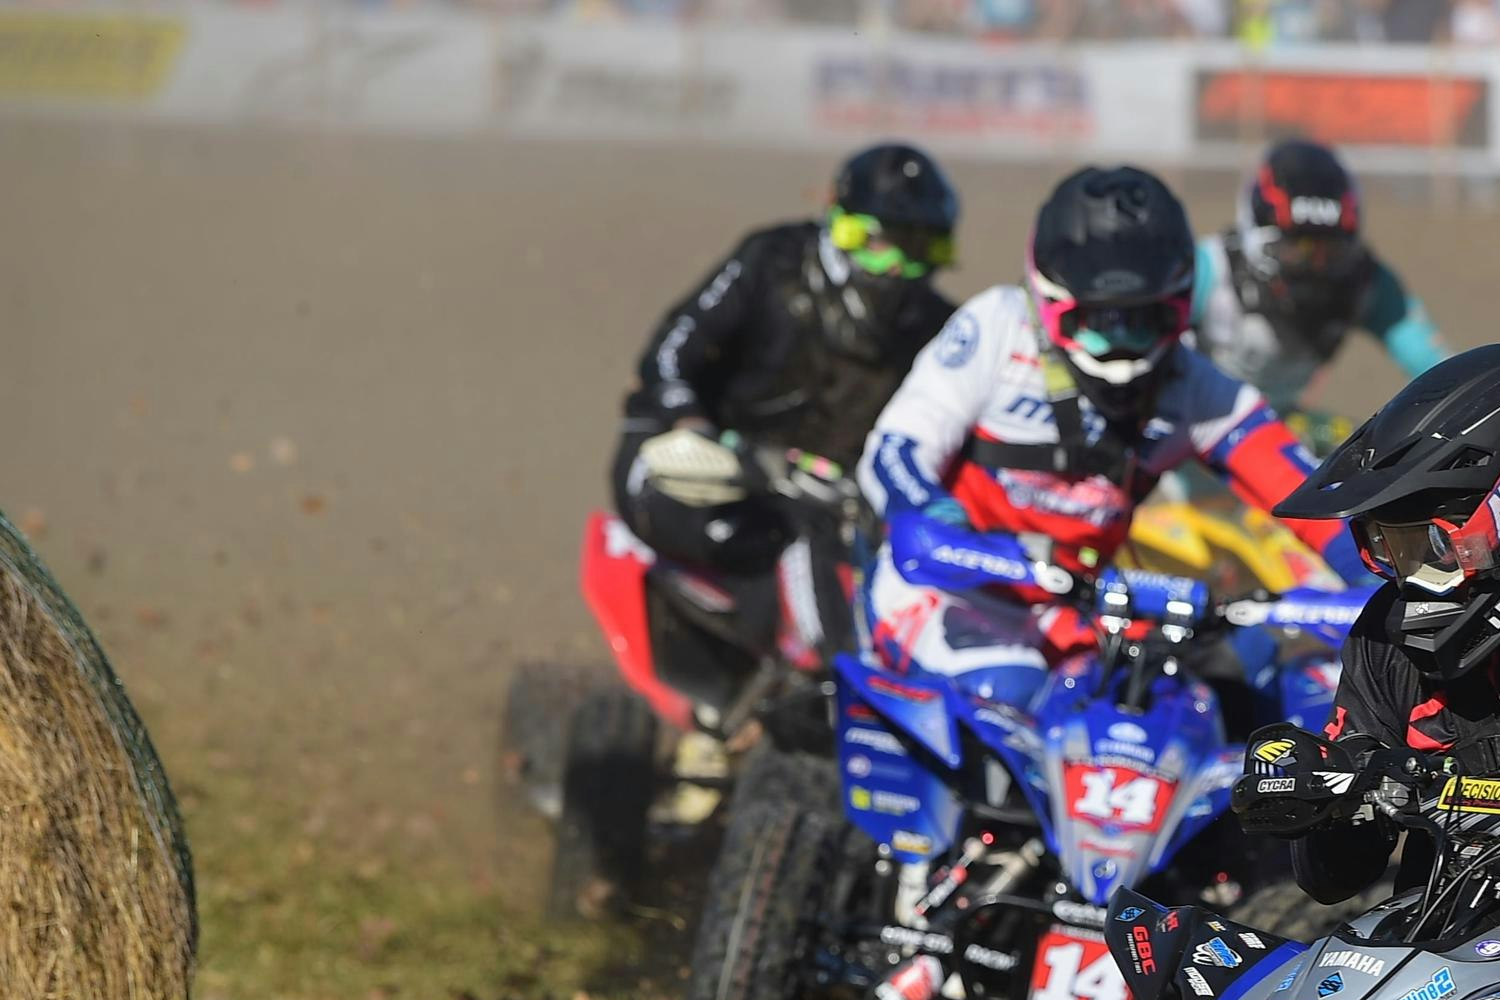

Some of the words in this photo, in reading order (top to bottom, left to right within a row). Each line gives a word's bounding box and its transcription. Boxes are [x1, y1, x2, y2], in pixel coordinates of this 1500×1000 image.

[1075, 769, 1158, 823] 14
[1258, 778, 1295, 793] CYCRA
[1133, 926, 1156, 975] GBC
[1318, 950, 1385, 977] YAMAHA
